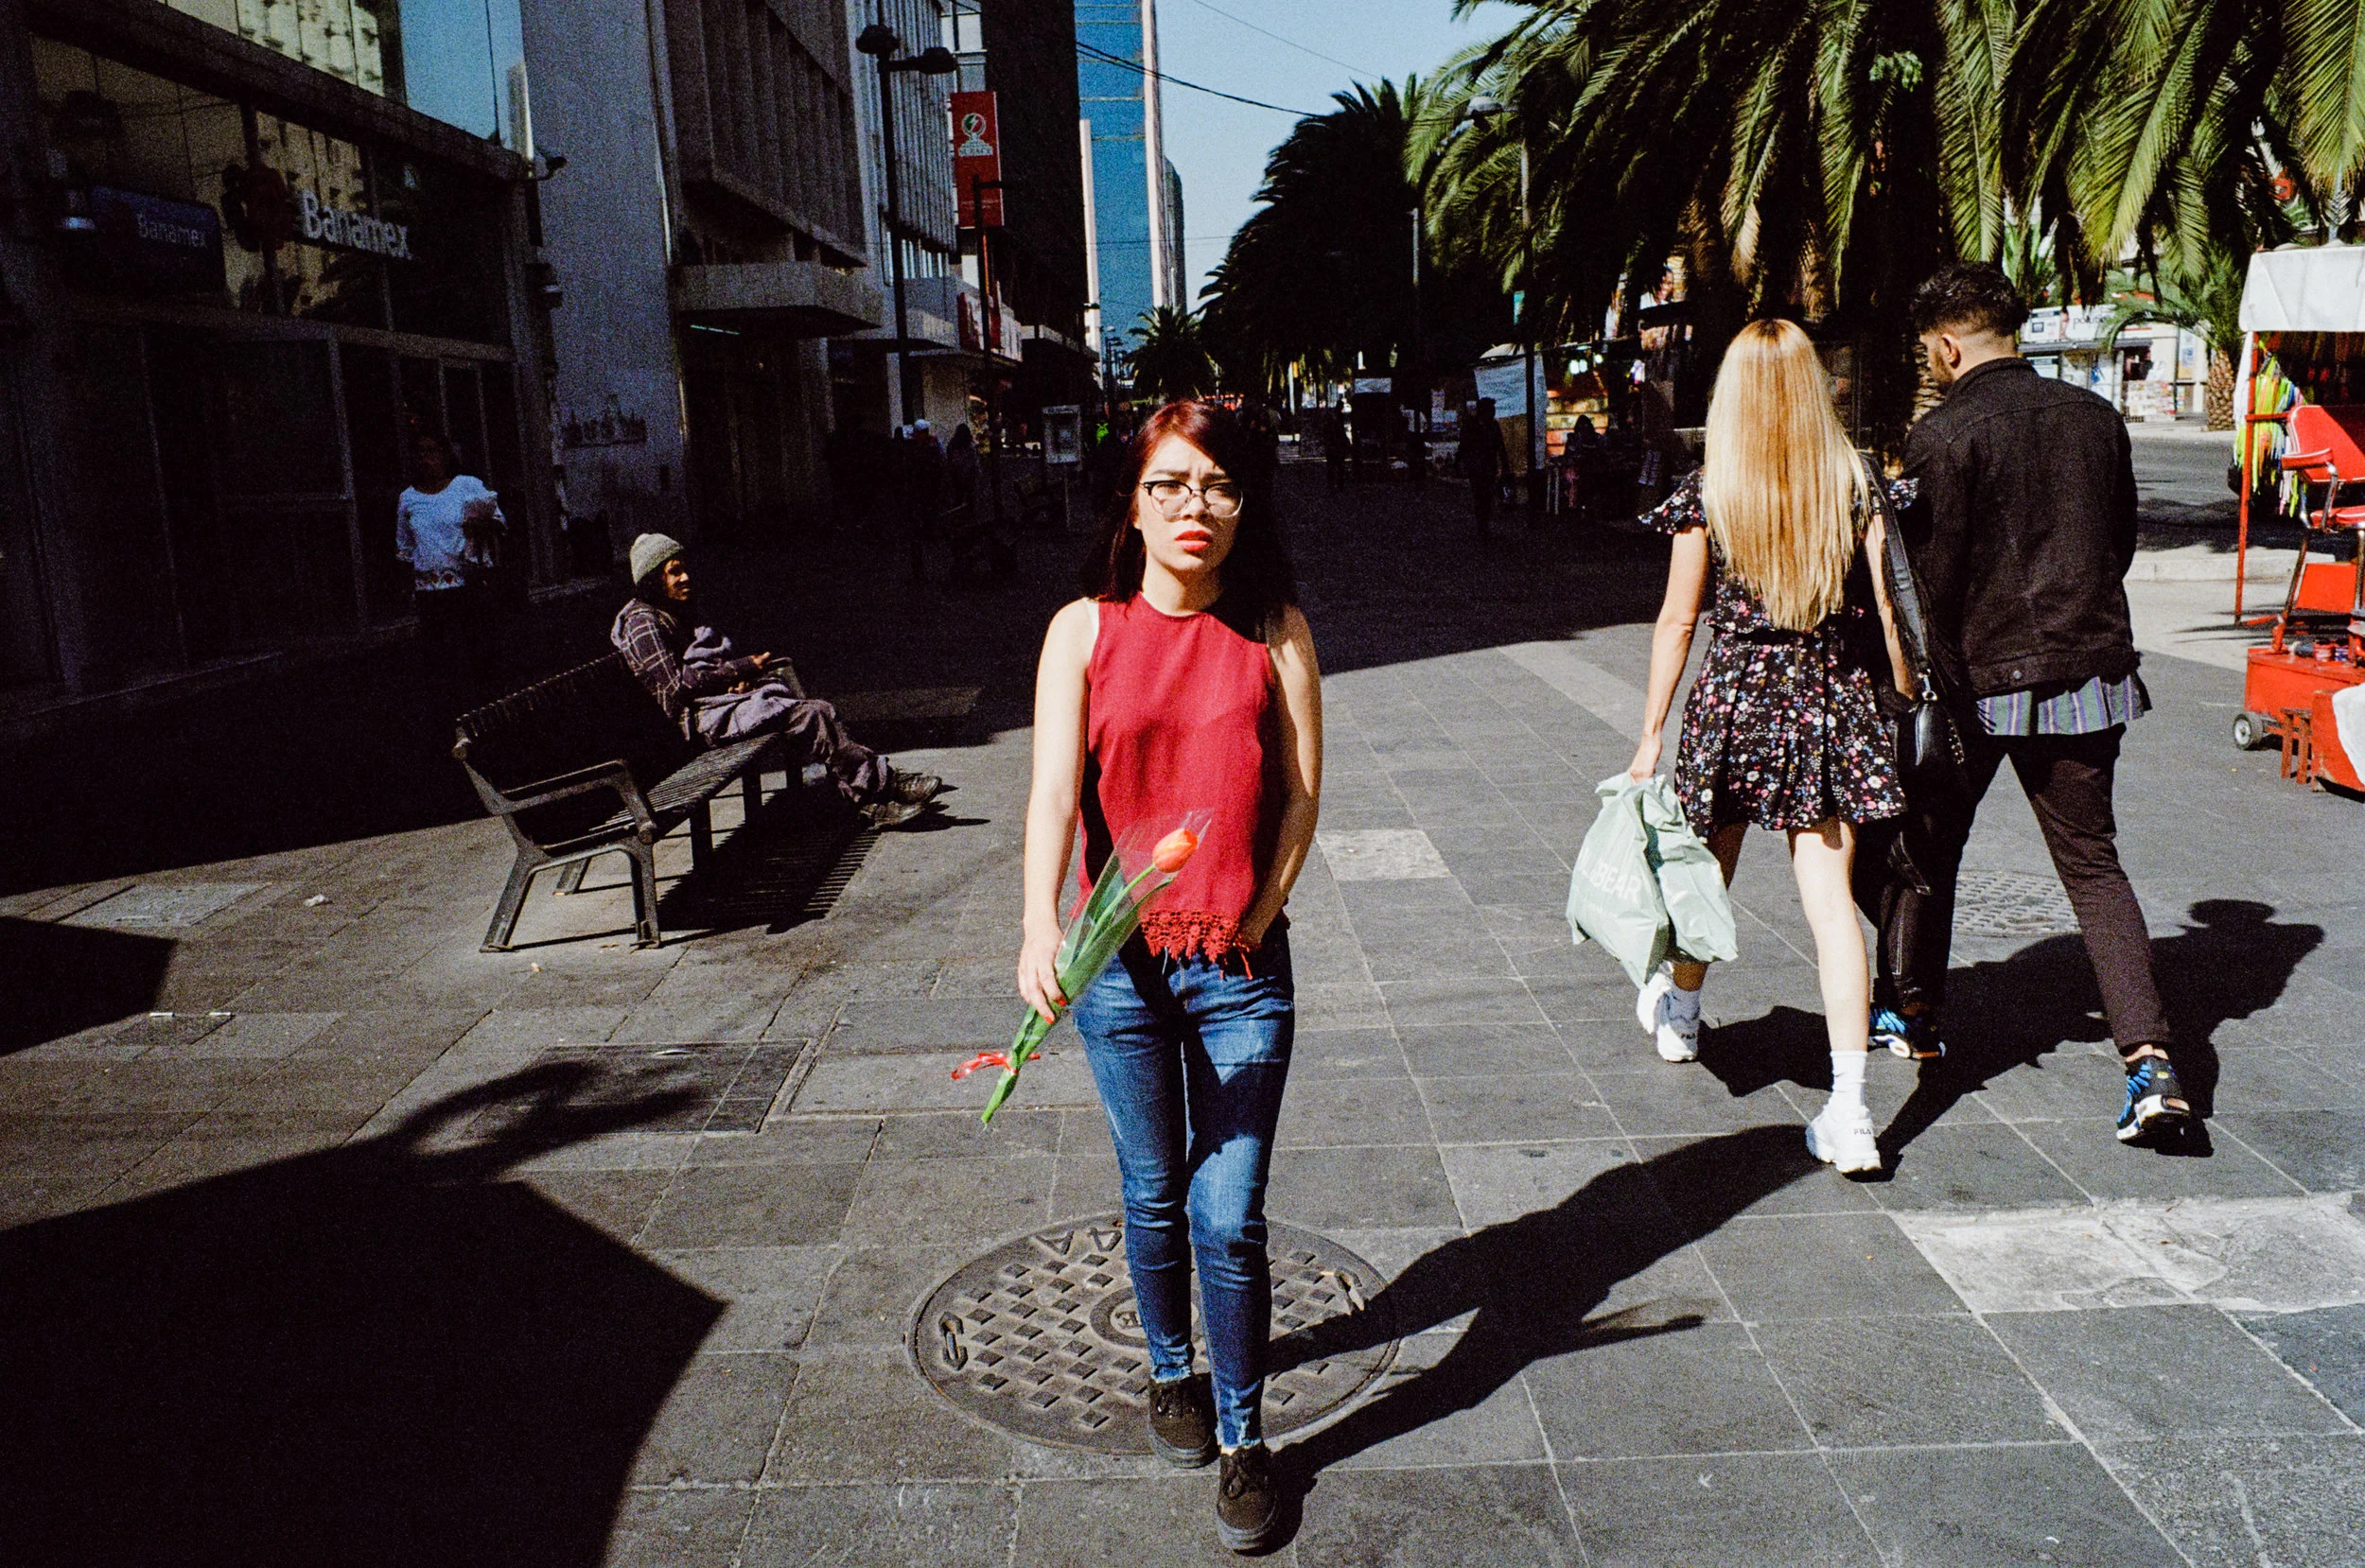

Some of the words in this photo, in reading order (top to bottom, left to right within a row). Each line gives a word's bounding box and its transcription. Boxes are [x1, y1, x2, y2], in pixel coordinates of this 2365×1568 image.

[136, 212, 206, 247] Banamex
[299, 189, 412, 260] Banamex
[1853, 1127, 1872, 1136] FILA
